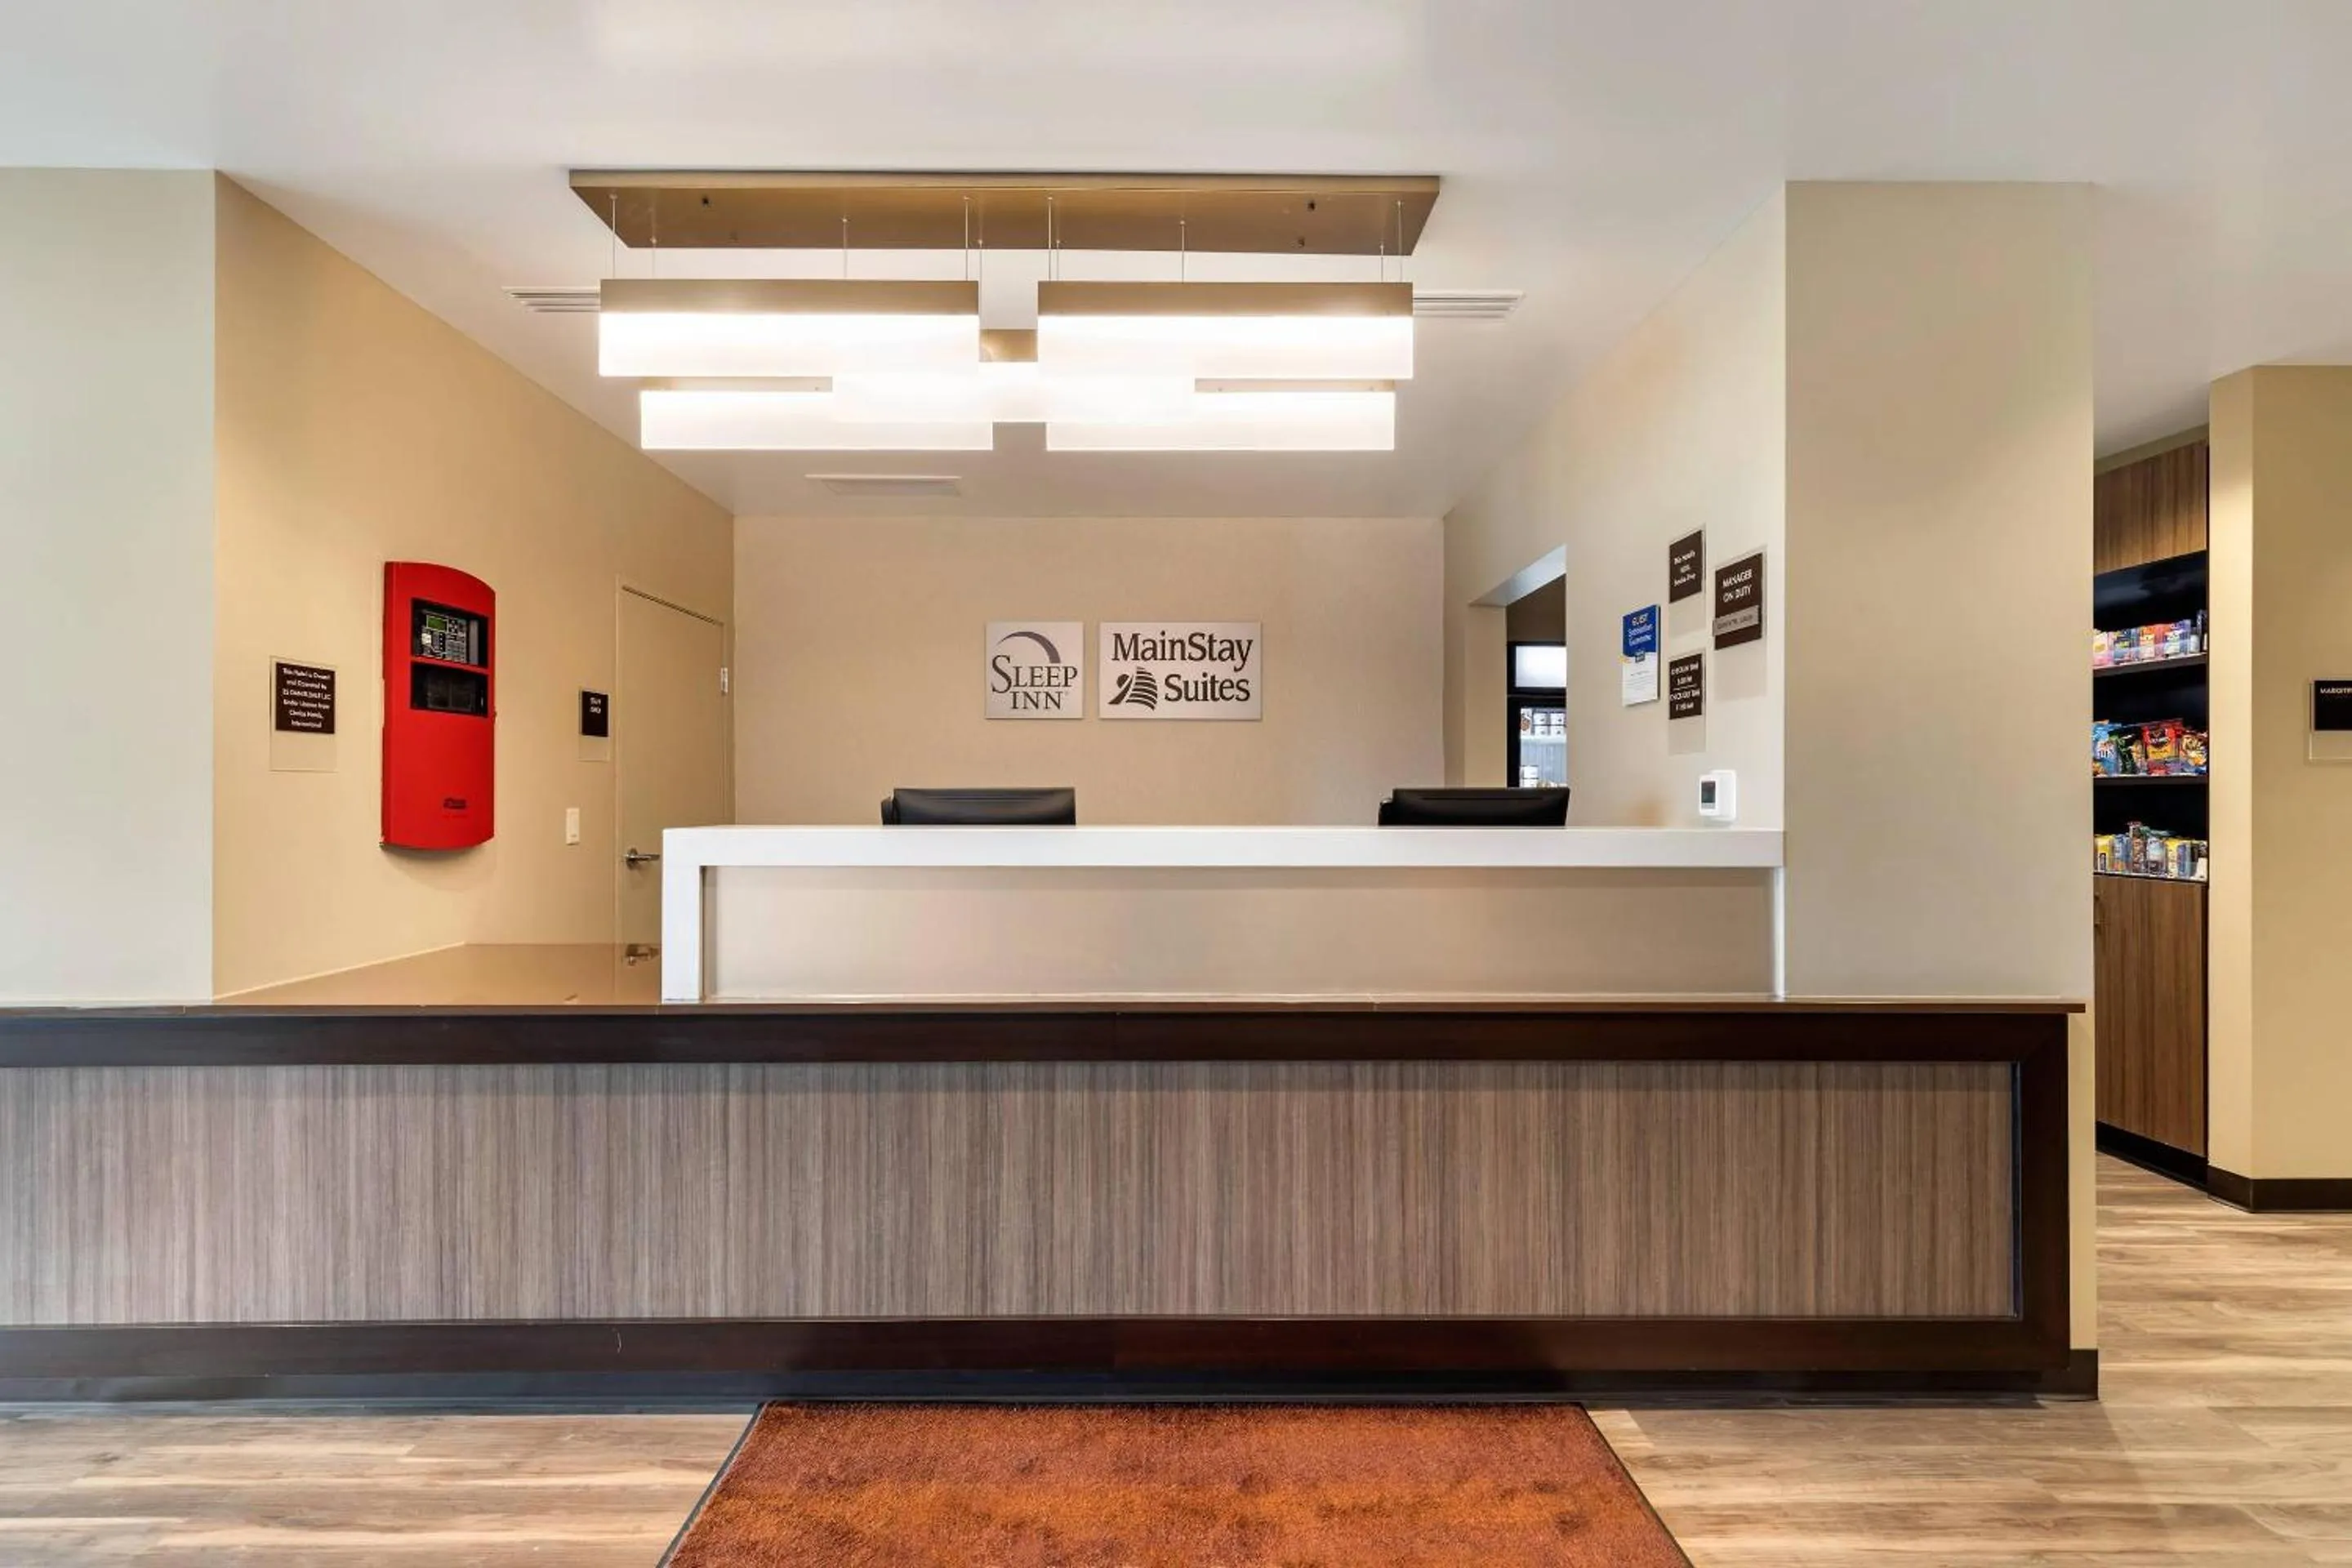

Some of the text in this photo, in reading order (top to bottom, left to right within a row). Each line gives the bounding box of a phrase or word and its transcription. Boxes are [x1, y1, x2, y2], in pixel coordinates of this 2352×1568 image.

[1111, 630, 1254, 672] MainStay
[991, 655, 1078, 693] SLEEP
[1165, 672, 1250, 702] Suites
[1010, 691, 1063, 710] INN
